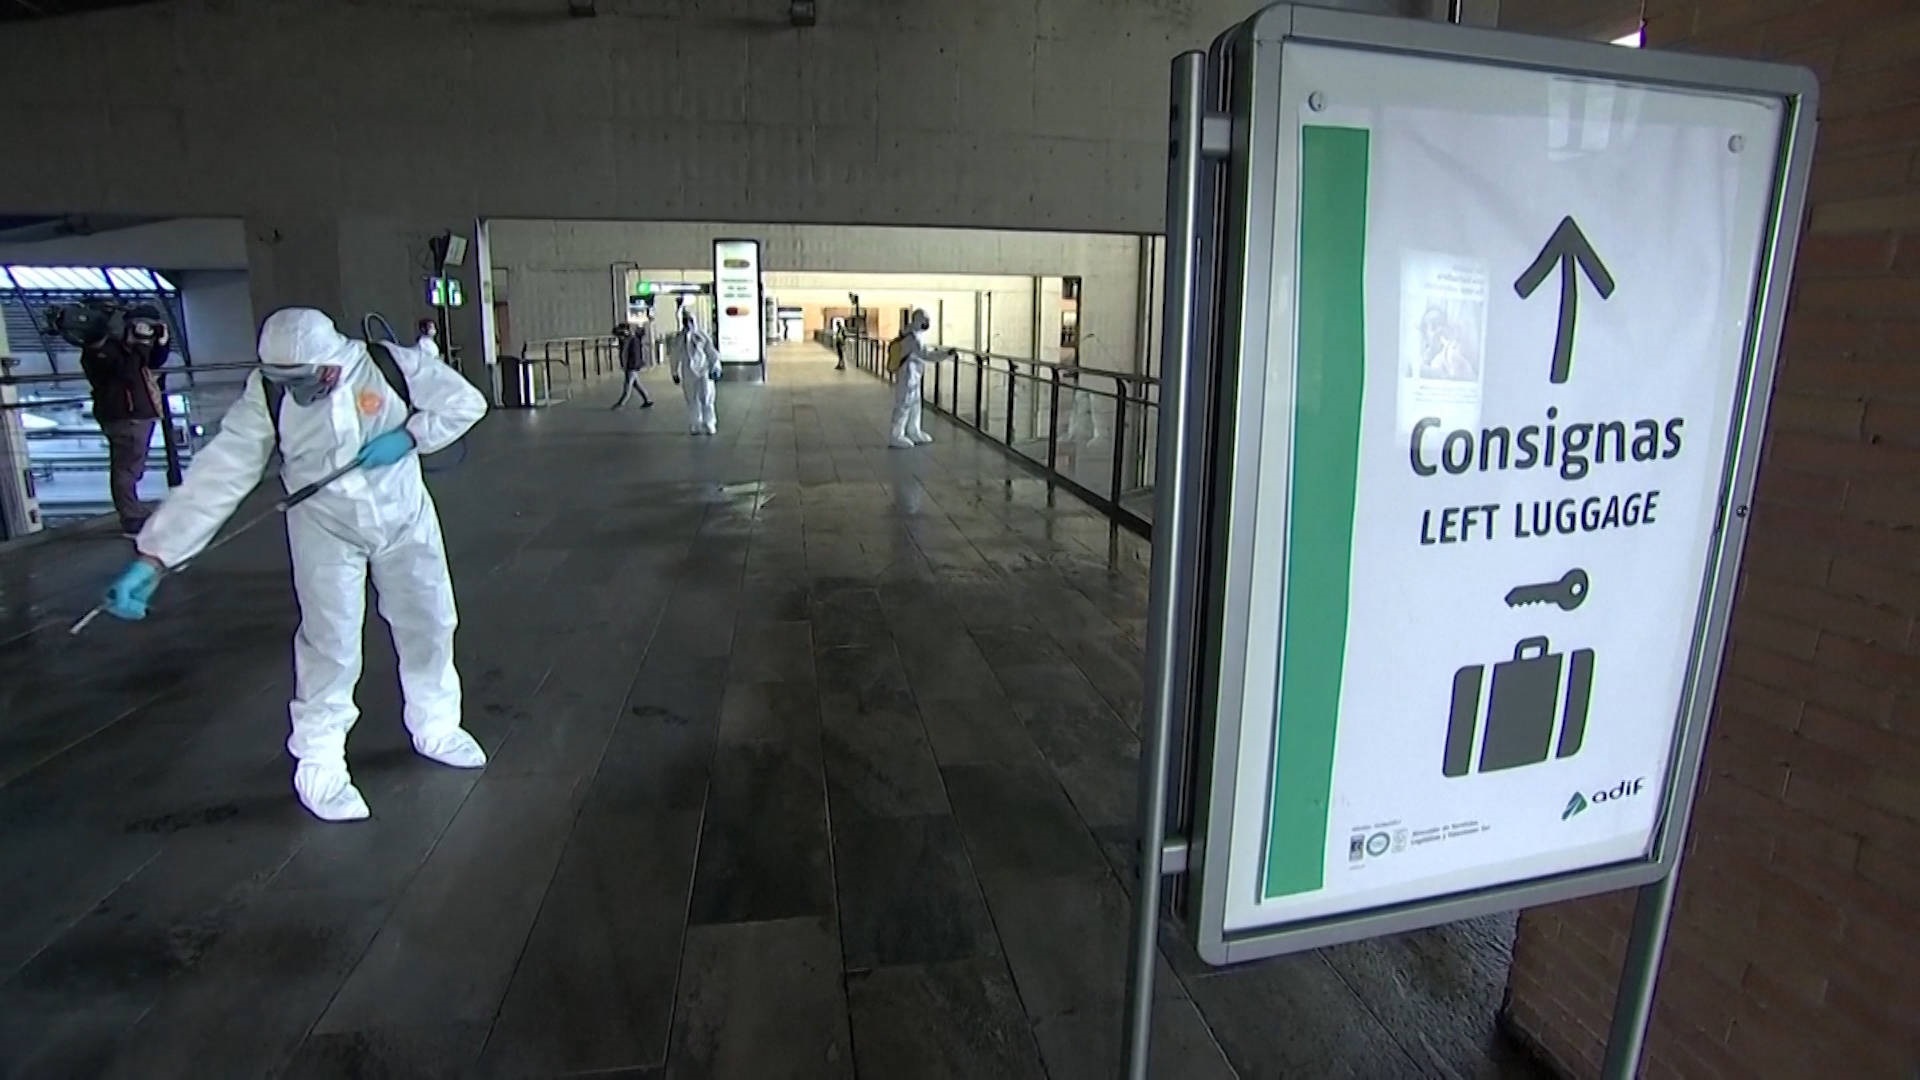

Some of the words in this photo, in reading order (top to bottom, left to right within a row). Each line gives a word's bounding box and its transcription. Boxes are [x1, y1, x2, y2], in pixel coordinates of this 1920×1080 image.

[1410, 406, 1684, 480] Consignas
[1420, 504, 1500, 545] LEFT
[1515, 490, 1660, 537] LUGGAGE
[1592, 777, 1646, 803] adif
